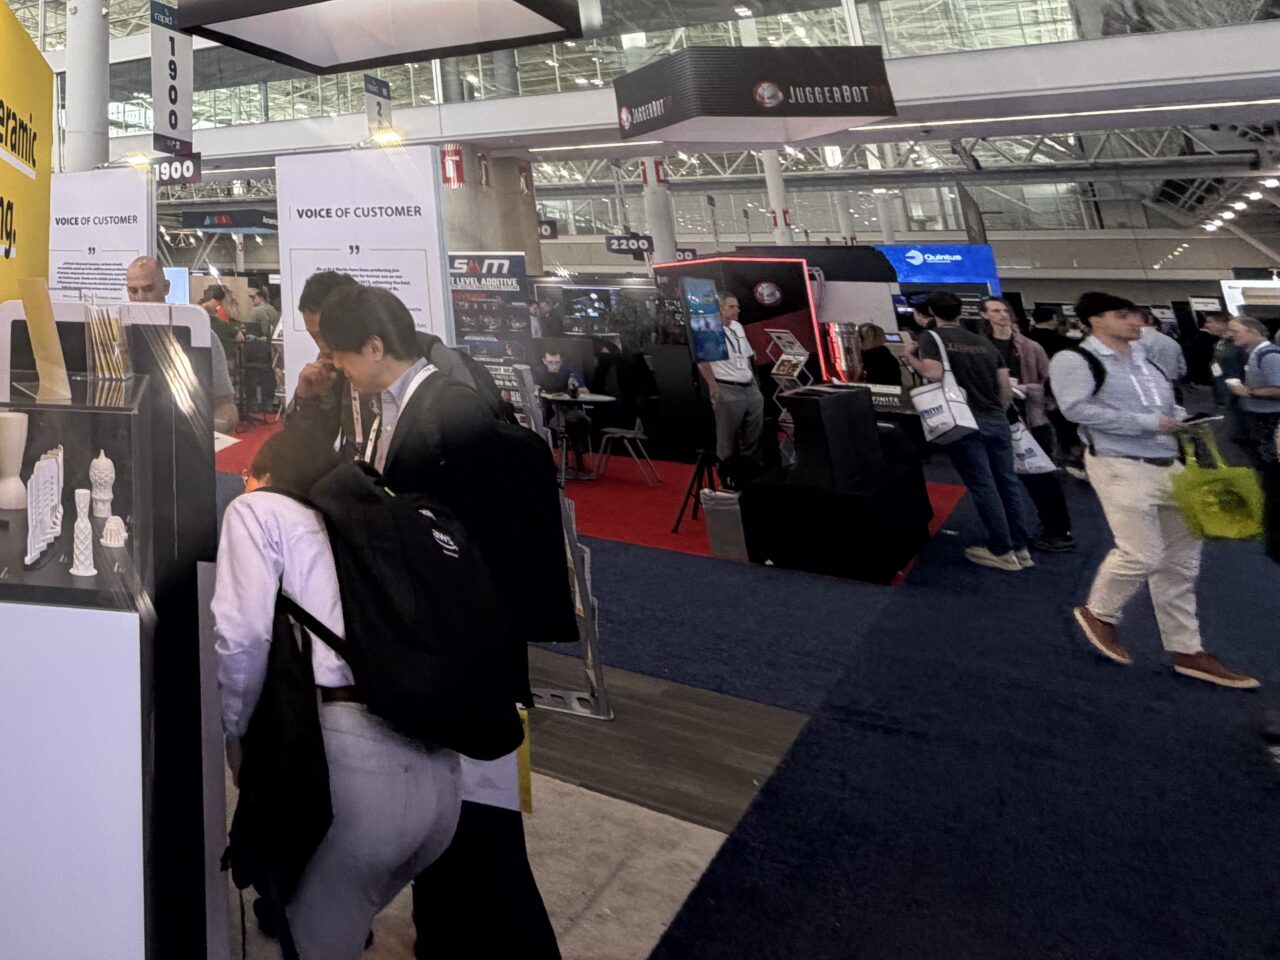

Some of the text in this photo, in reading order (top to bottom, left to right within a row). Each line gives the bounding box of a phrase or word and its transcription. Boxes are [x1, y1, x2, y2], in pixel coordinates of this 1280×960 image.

[154, 12, 173, 25] rapid
[168, 36, 178, 131] 1900
[153, 160, 194, 181] 1900
[296, 206, 423, 219] VOICE OF CUSTOMER
[55, 215, 138, 226] VOICE OF CUSTOMER
[610, 239, 649, 250] 2200
[924, 253, 963, 261] Quintus
[457, 277, 479, 286] LEVEL
[481, 277, 518, 286] ADDITIVE
